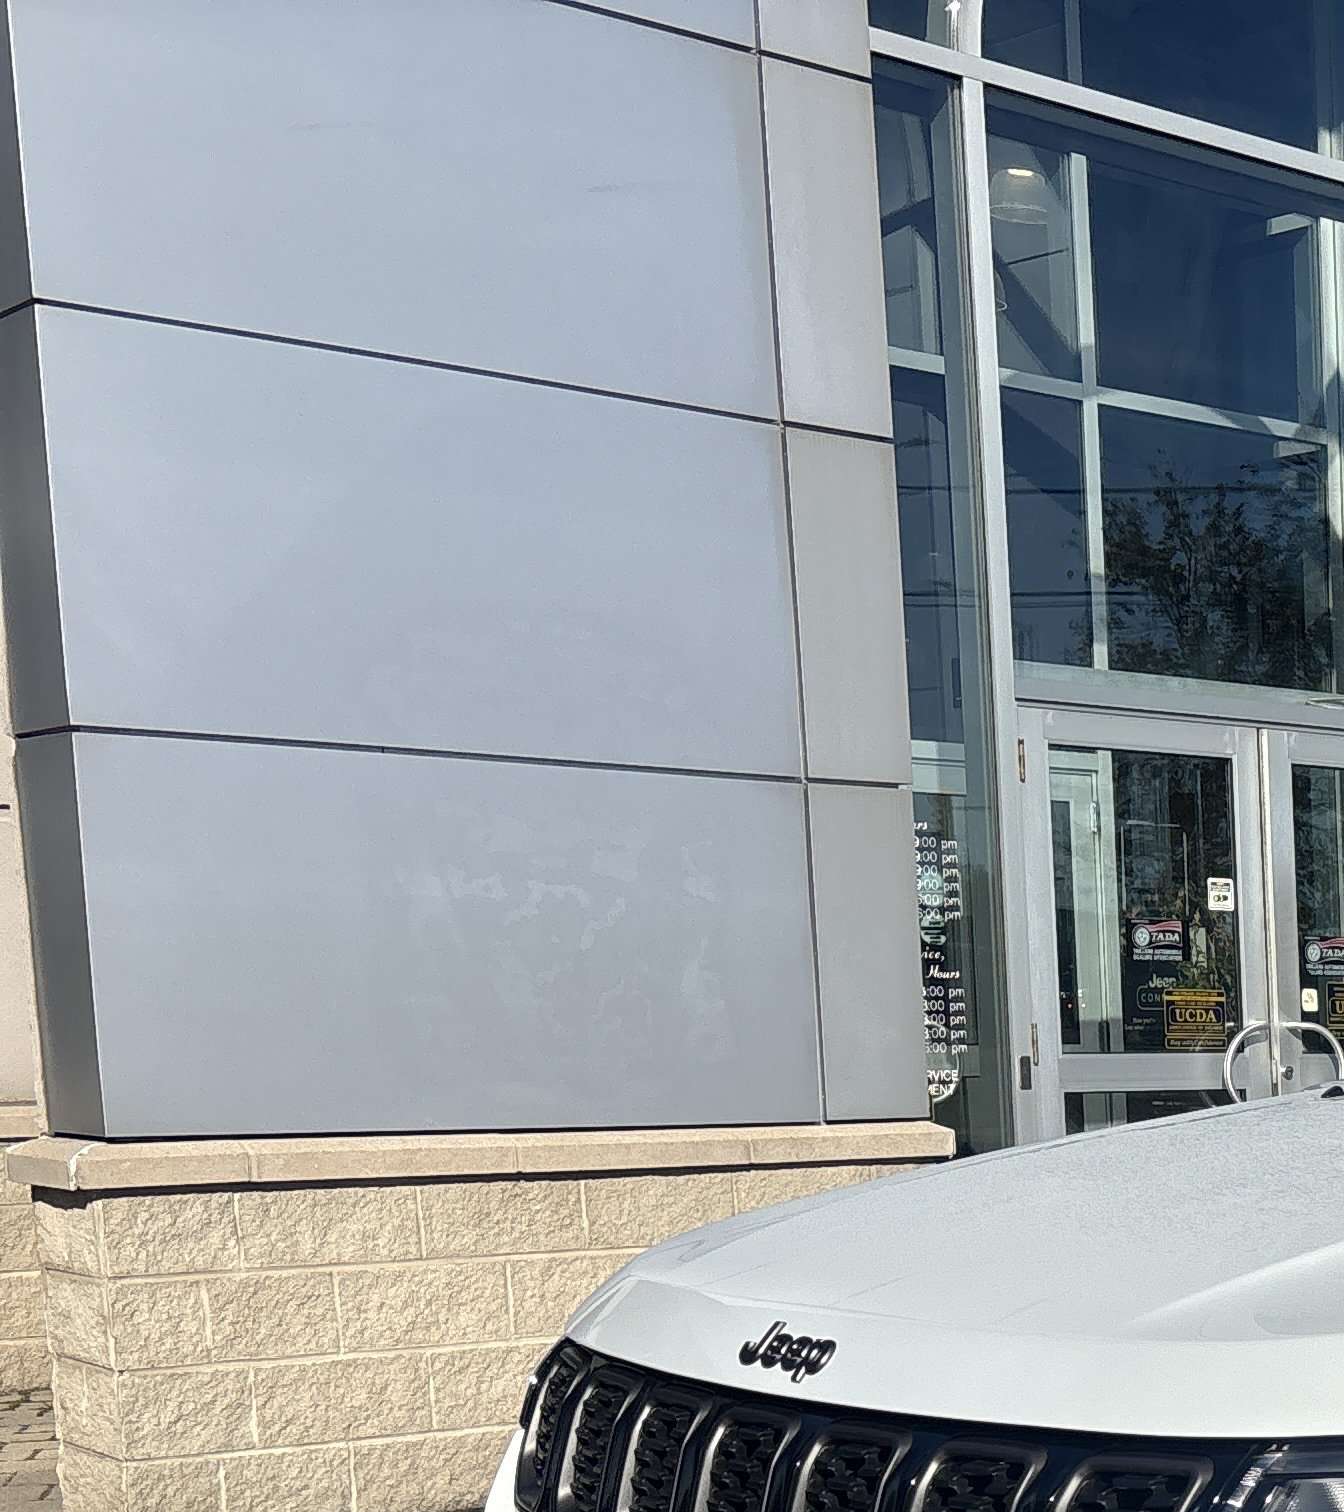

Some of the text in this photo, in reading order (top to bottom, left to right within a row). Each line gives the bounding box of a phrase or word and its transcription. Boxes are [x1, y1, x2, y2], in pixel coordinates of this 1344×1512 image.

[941, 840, 958, 850] pm
[941, 854, 959, 865] pm
[943, 868, 960, 879] pm
[943, 882, 960, 894] pm
[944, 896, 960, 908] pm
[944, 911, 961, 922] pm
[1151, 932, 1180, 942] TADA
[925, 964, 960, 979] Hours
[948, 988, 965, 999] pm
[949, 1002, 966, 1013] pm
[1175, 1008, 1217, 1022] UCDA
[950, 1015, 966, 1027] pm
[951, 1030, 967, 1041] pm
[951, 1044, 968, 1055] pm
[738, 1320, 837, 1384] Jeep
